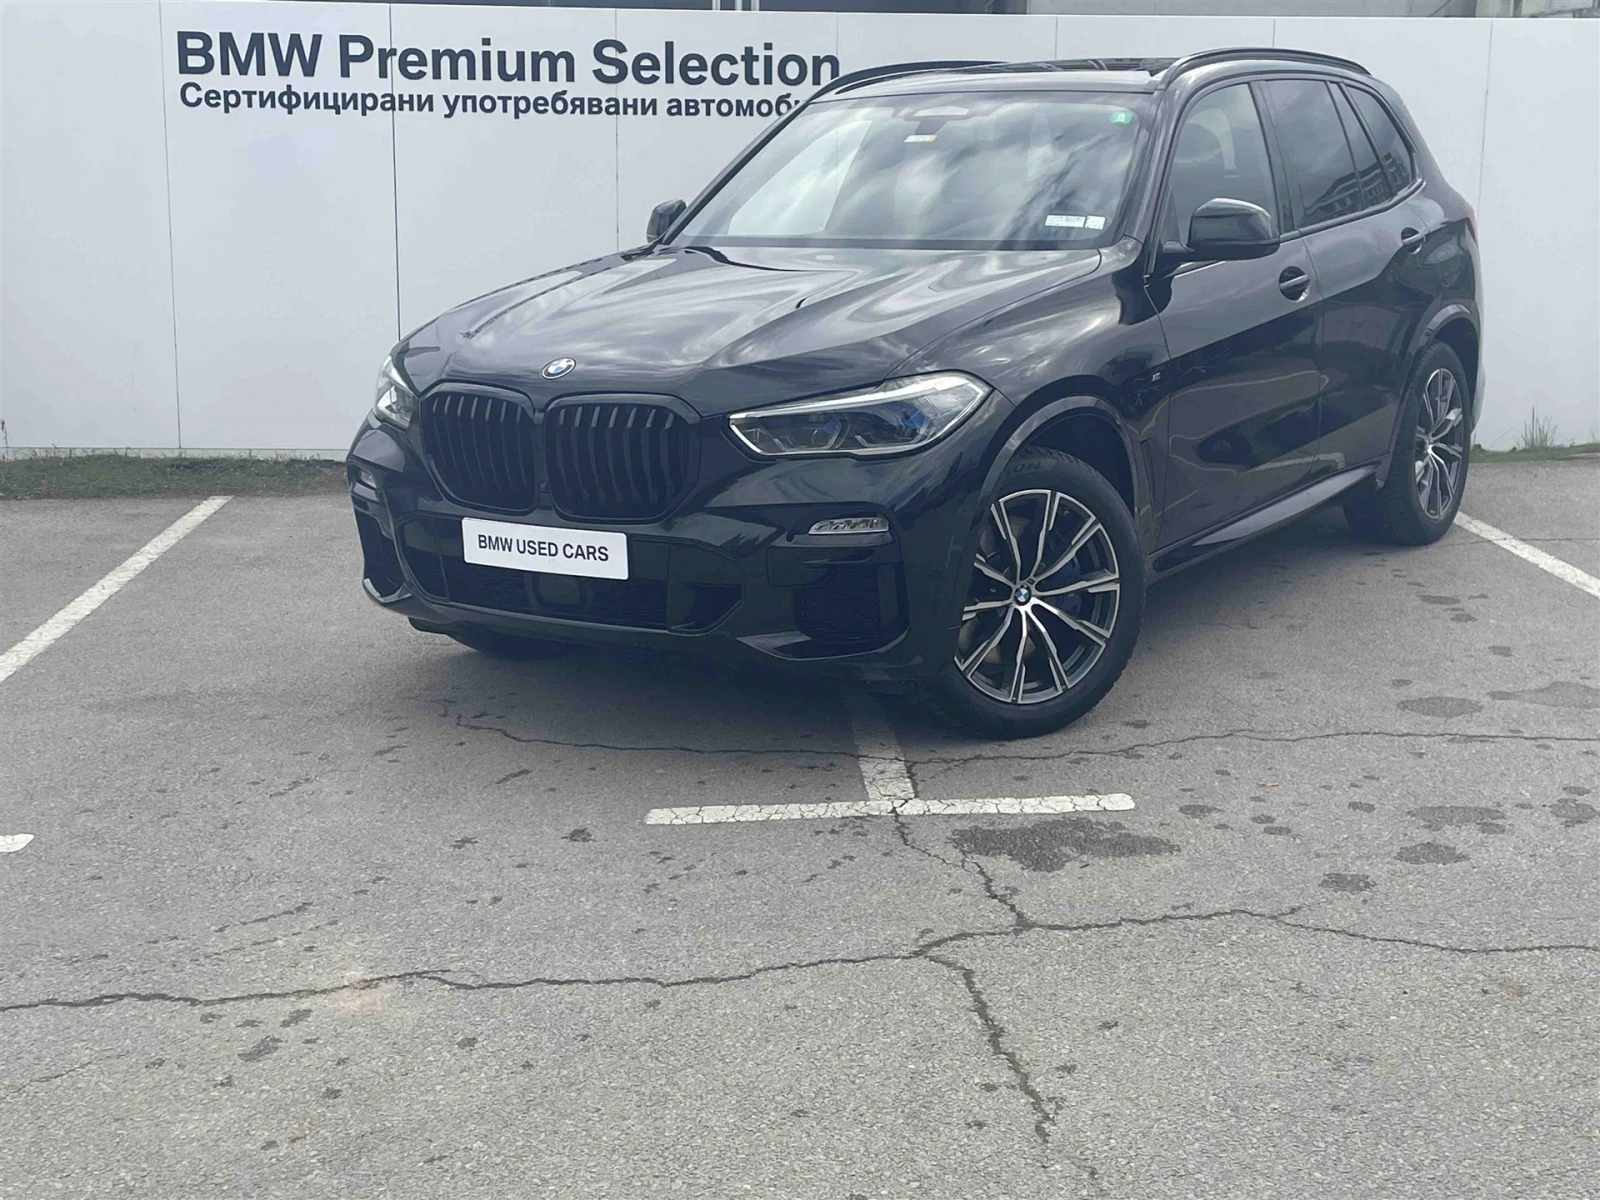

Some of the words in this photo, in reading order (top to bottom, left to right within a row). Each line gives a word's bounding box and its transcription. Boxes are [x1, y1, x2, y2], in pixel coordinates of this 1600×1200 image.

[177, 30, 322, 77] BMW
[339, 34, 575, 82] Premium
[592, 38, 840, 86] Selection
[179, 82, 434, 116] Сертифицирани
[443, 90, 657, 119] употребявани
[666, 92, 800, 117] автомоб
[478, 534, 513, 552] BMW
[516, 539, 558, 557] USED
[562, 543, 608, 562] CARS
